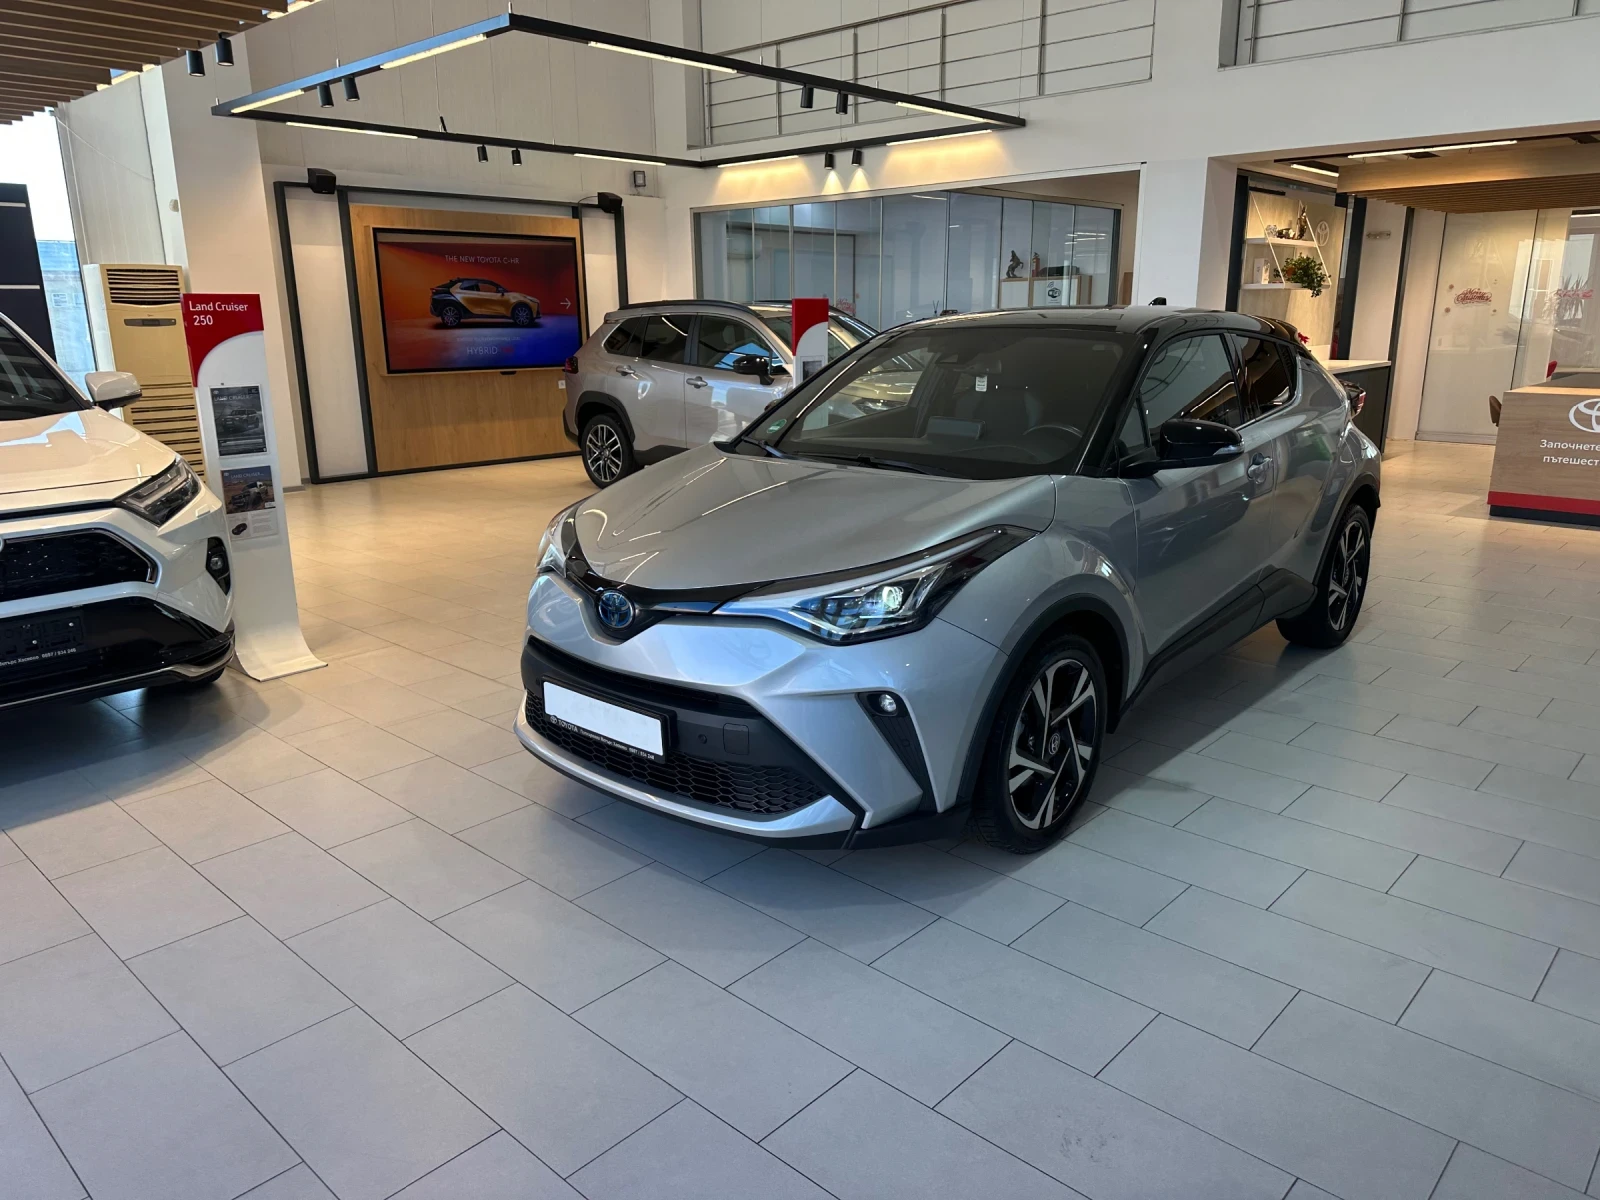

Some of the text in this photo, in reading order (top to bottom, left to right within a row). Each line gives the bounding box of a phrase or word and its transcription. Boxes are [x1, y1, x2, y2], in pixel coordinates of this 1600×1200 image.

[445, 254, 520, 265] THE NEW TOYOTA C-HR
[189, 300, 248, 312] Land Cruiser
[193, 314, 214, 326] 250
[466, 346, 498, 355] HYBRID
[1540, 439, 1600, 452] Започнете
[558, 719, 578, 733] TOYOTA
